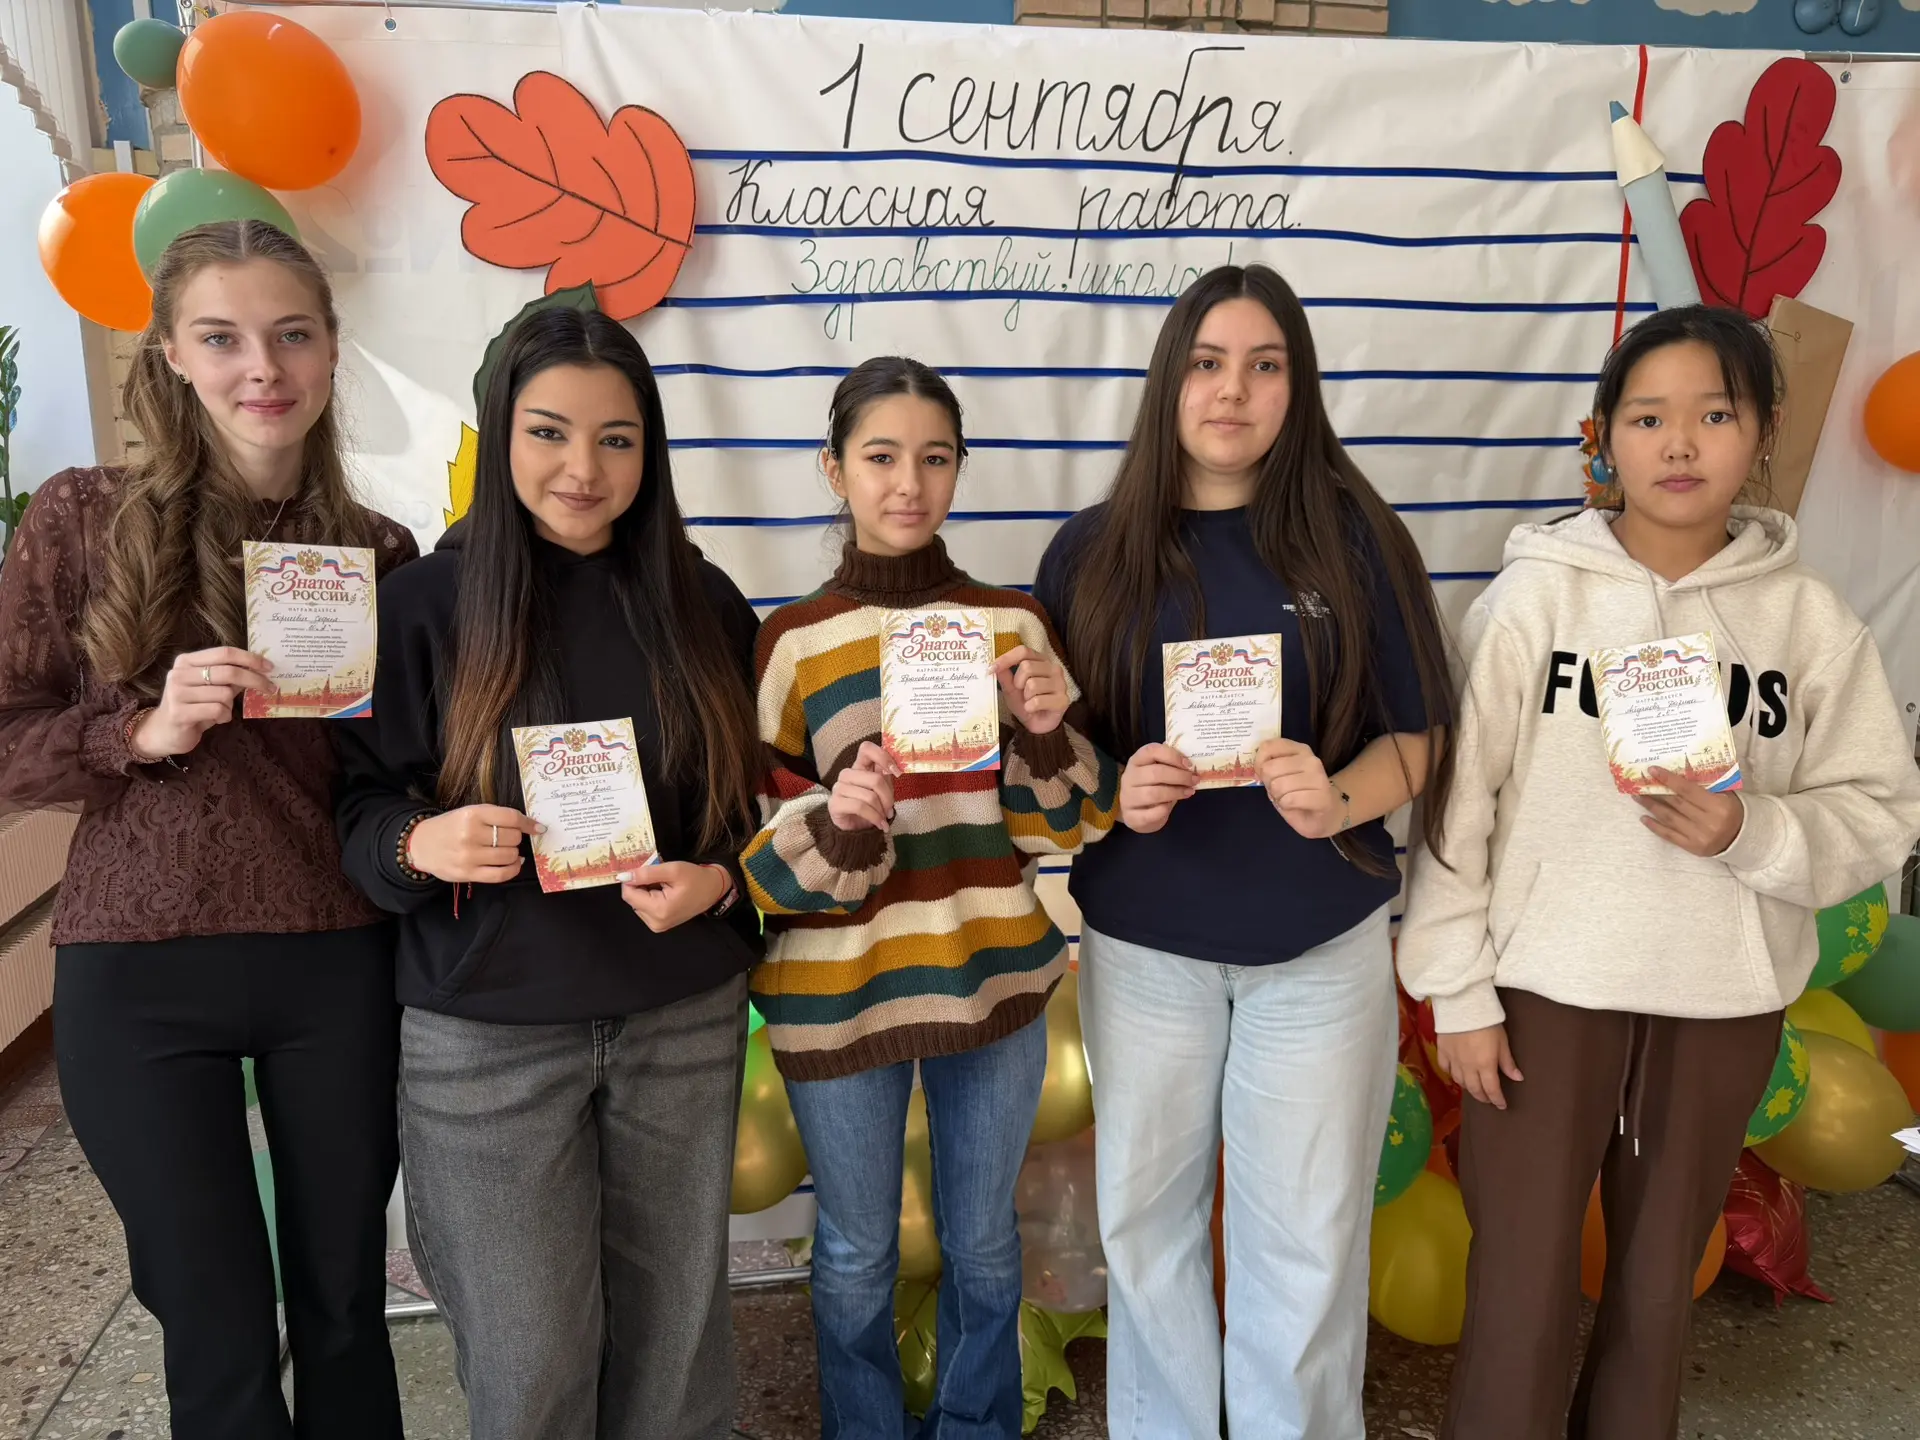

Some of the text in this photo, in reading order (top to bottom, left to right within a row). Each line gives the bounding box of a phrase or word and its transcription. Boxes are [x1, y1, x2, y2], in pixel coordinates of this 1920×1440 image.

[820, 43, 865, 150] 1
[725, 159, 995, 228] Классная
[271, 569, 346, 596] Знаток
[292, 590, 350, 602] РОССИИ
[902, 634, 968, 659] Знаток
[920, 650, 972, 662] РОССИИ
[1187, 663, 1255, 687] Знаток
[1205, 677, 1257, 689] РОССИИ
[1617, 666, 1689, 692] Знаток
[1638, 675, 1695, 693] РОССИИ
[544, 750, 612, 775] Знаток
[563, 761, 617, 777] РОССИИ
